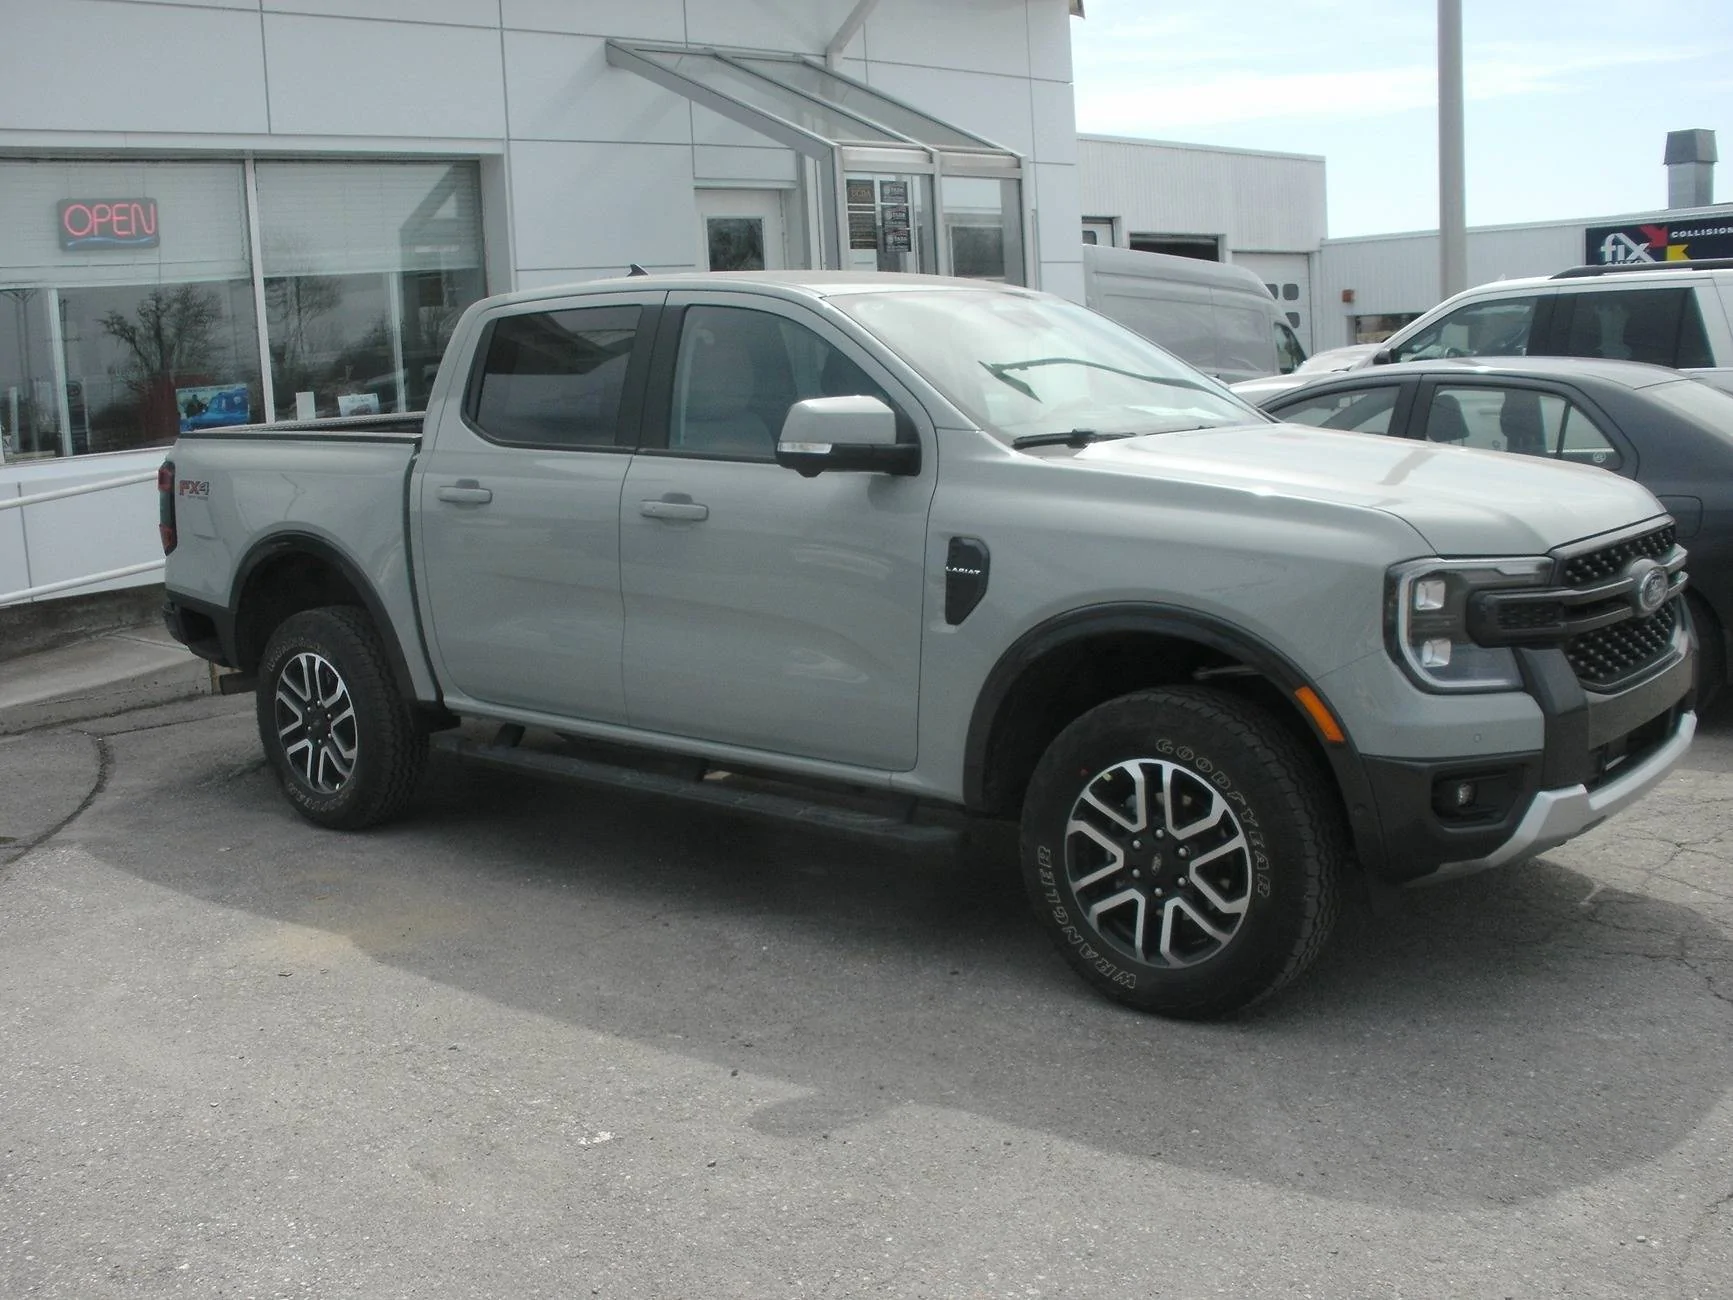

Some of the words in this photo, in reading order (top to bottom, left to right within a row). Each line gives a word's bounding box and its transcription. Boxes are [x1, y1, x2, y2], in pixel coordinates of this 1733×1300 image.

[64, 203, 156, 236] OPEN
[1600, 231, 1656, 264] fix
[179, 480, 210, 496] FX4
[1156, 739, 1271, 897] GOODYEAR
[1037, 845, 1137, 989] WRANGLER
